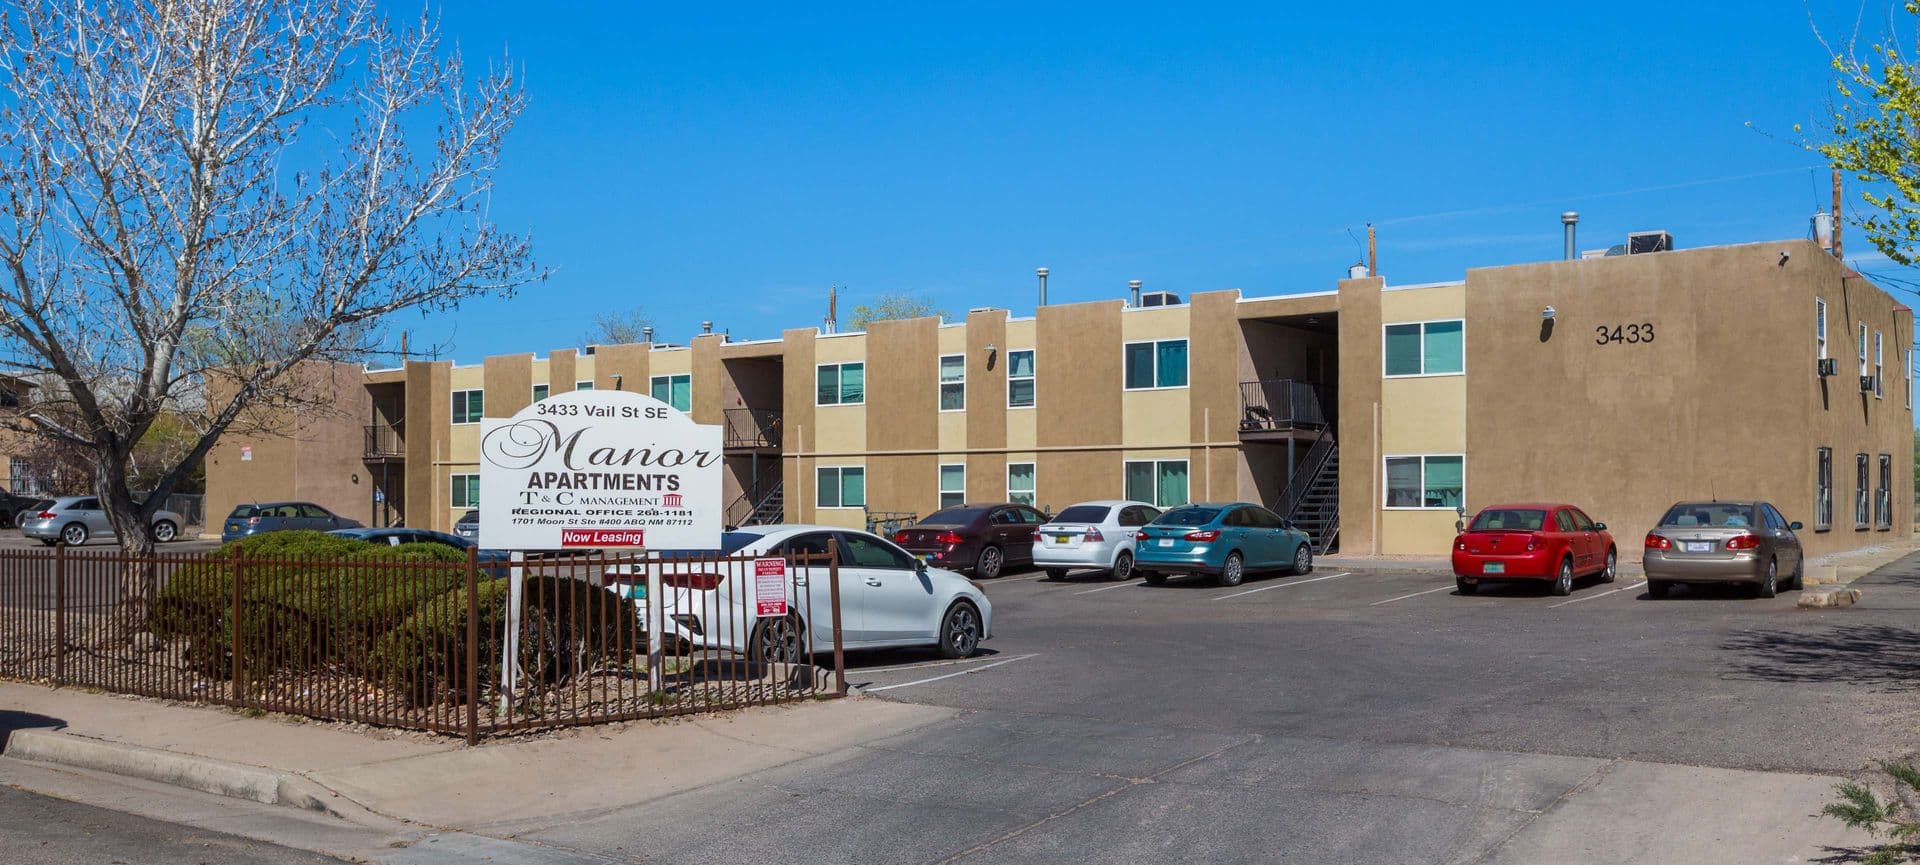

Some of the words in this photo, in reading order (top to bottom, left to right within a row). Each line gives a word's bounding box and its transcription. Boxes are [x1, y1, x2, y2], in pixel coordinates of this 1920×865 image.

[1596, 323, 1655, 345] 3433
[537, 403, 578, 417] 3433
[584, 405, 615, 418] Vail
[622, 406, 639, 419] St
[644, 407, 668, 419] SE
[481, 418, 721, 471] Manor
[527, 472, 680, 491] APARTMENTS
[519, 491, 538, 505] T
[541, 495, 551, 504] &
[556, 491, 574, 506] C
[580, 497, 660, 506] MANAGEMENT
[511, 508, 581, 516] REGIONAL
[637, 509, 693, 517] 268-1181
[537, 518, 565, 526] Moon
[563, 532, 591, 543] Now
[594, 532, 641, 544] Leasing
